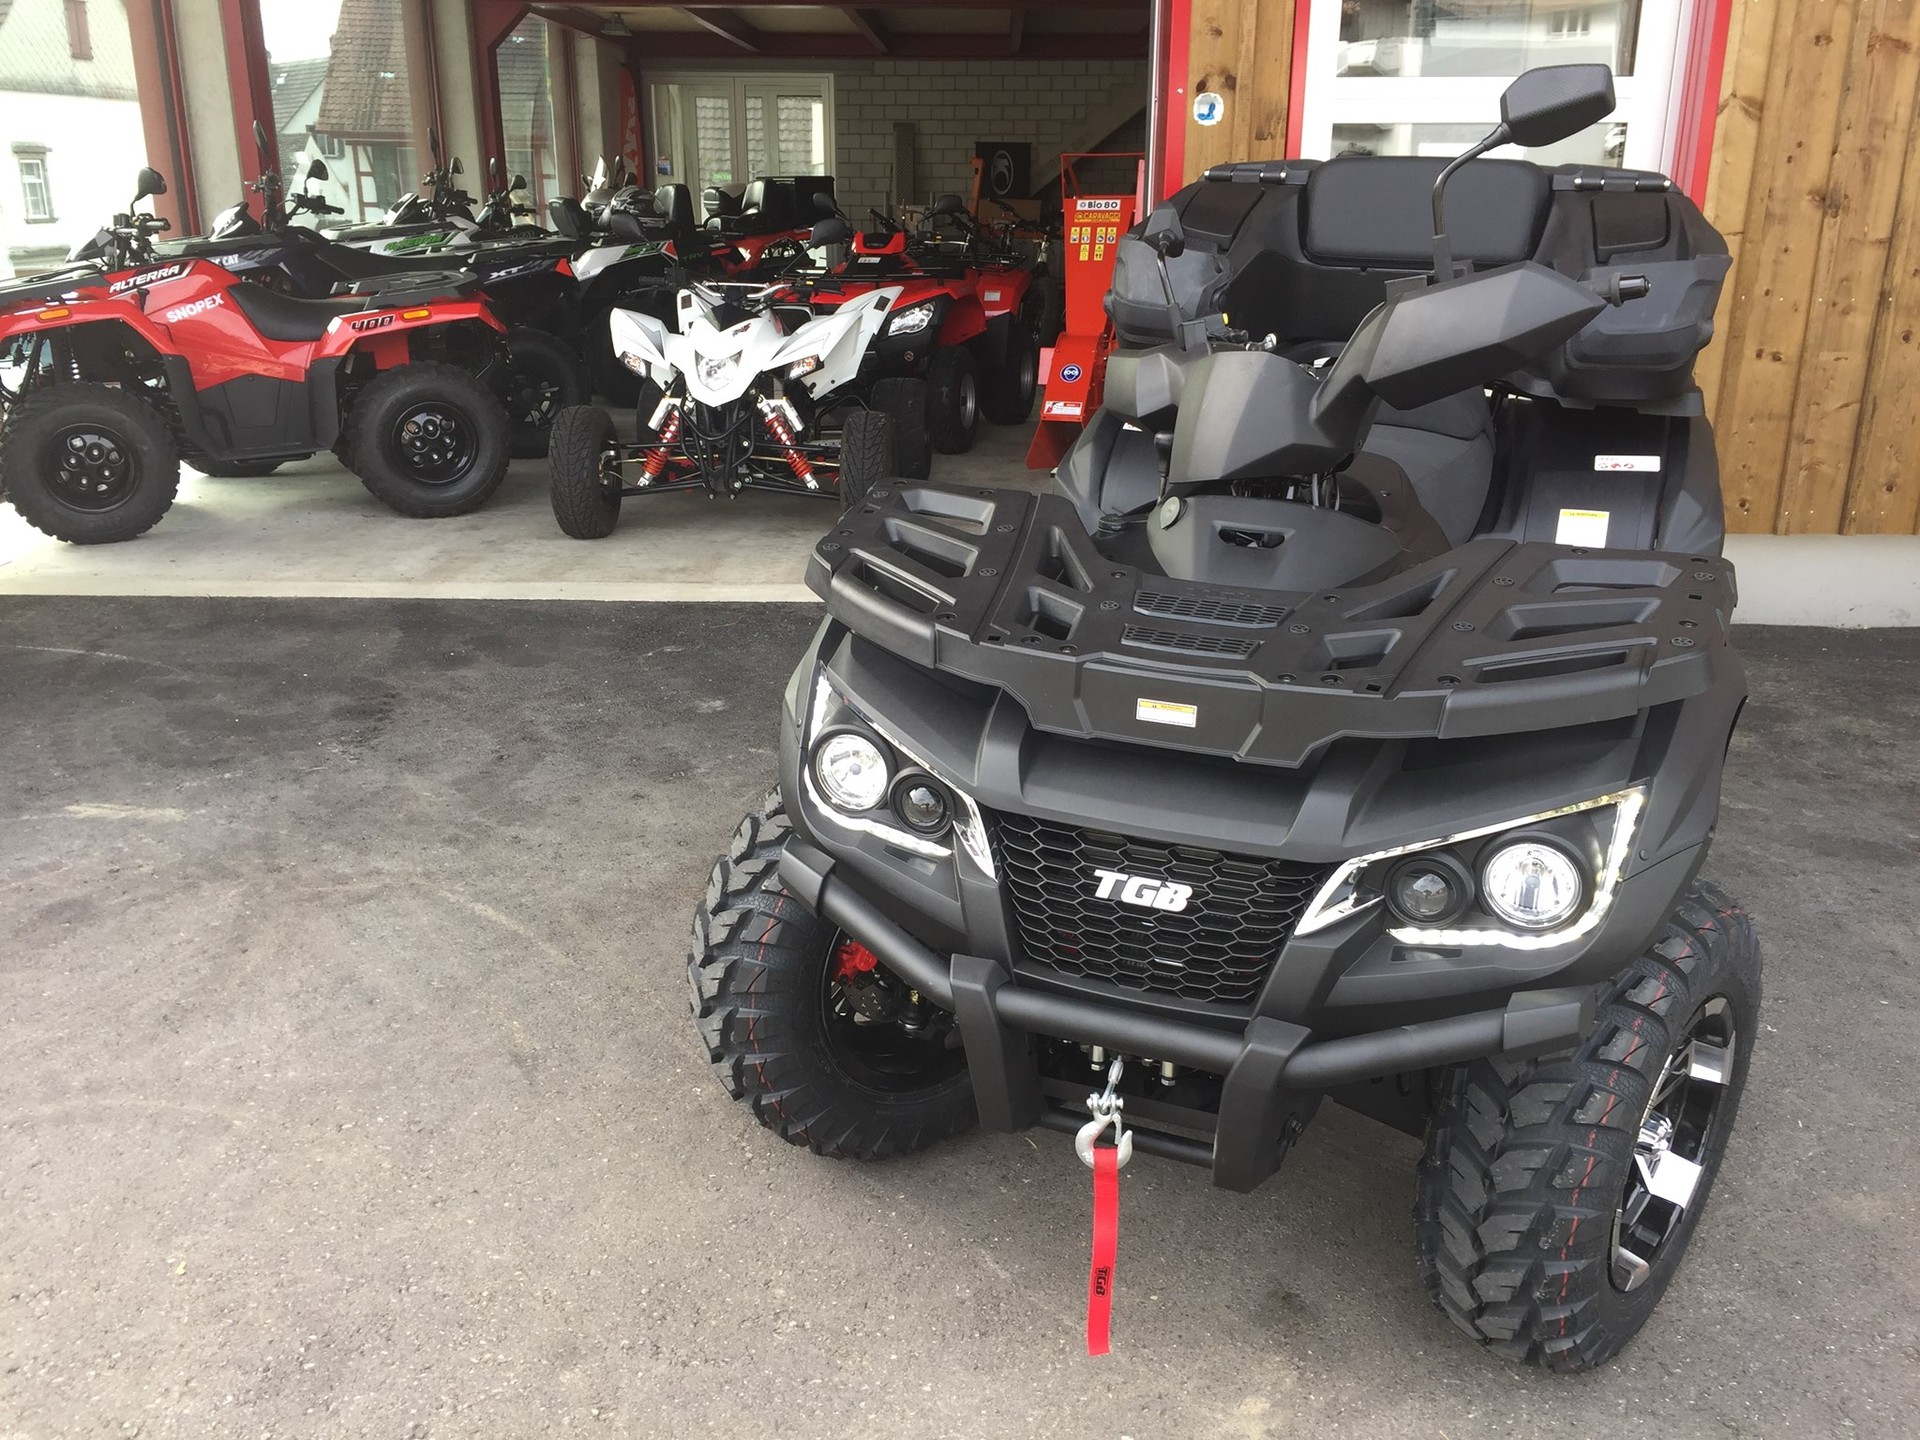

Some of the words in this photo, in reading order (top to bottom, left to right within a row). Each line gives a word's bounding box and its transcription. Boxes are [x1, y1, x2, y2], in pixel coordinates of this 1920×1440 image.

[1087, 201, 1103, 209] Bio
[1104, 201, 1118, 209] 80
[222, 254, 239, 266] CAT
[488, 265, 524, 279] XT
[109, 264, 180, 293] ALTERRA
[166, 292, 224, 323] SNOPEX
[351, 314, 395, 333] 400
[1093, 868, 1194, 913] TGB
[1095, 1266, 1110, 1296] TGB
